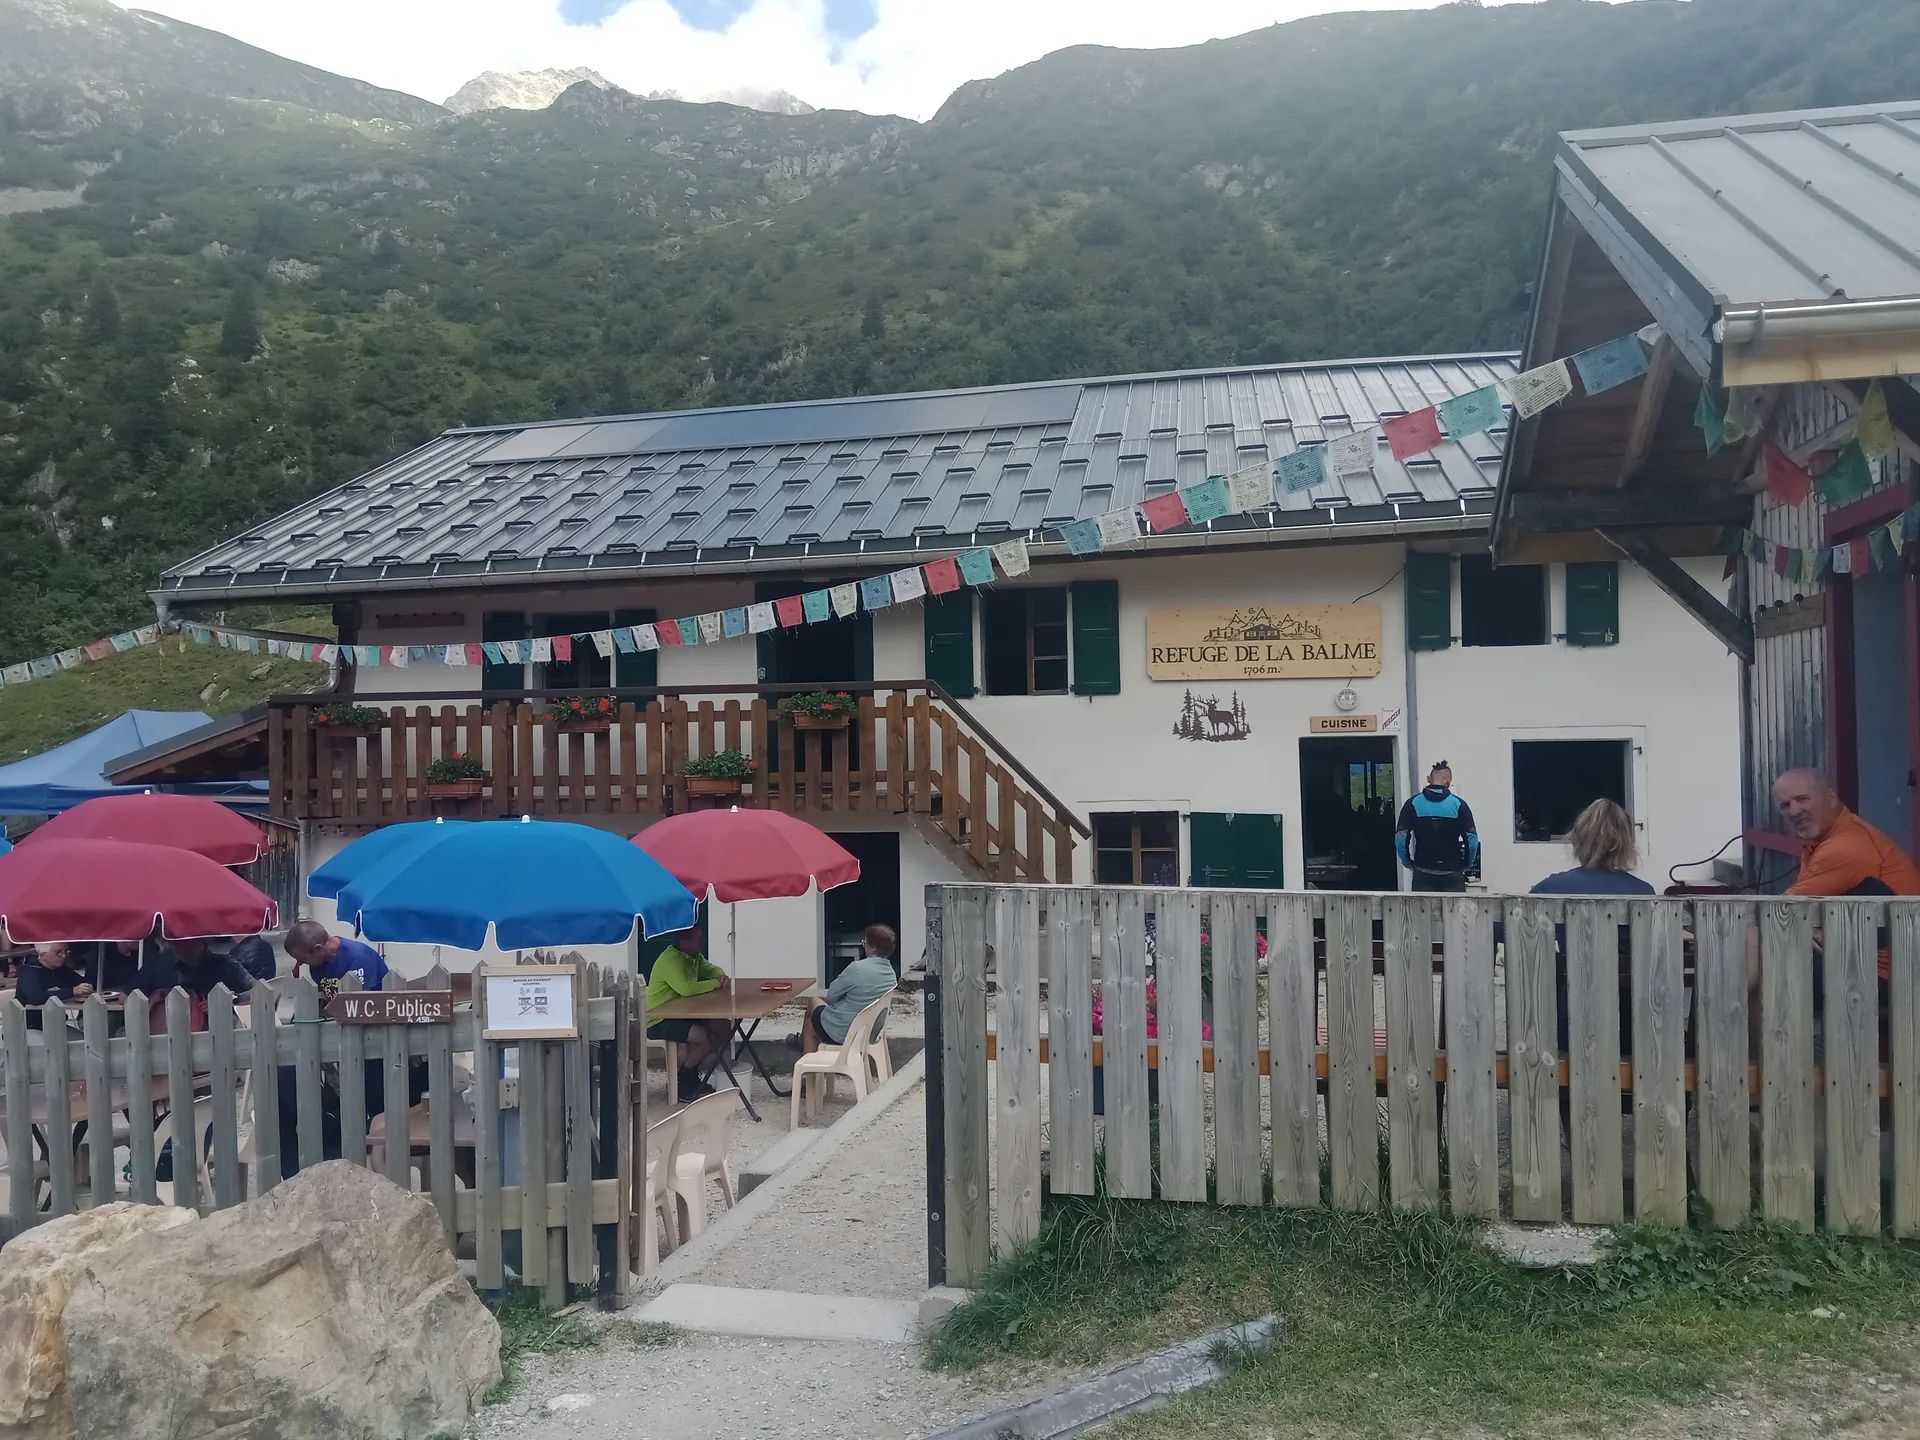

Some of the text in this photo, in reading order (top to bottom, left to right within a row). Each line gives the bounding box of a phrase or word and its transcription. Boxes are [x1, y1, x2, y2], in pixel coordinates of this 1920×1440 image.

[1151, 643, 1377, 664] REFUGE DE LA BALME
[1321, 719, 1367, 728] CUISINE
[385, 999, 441, 1016] Publics
